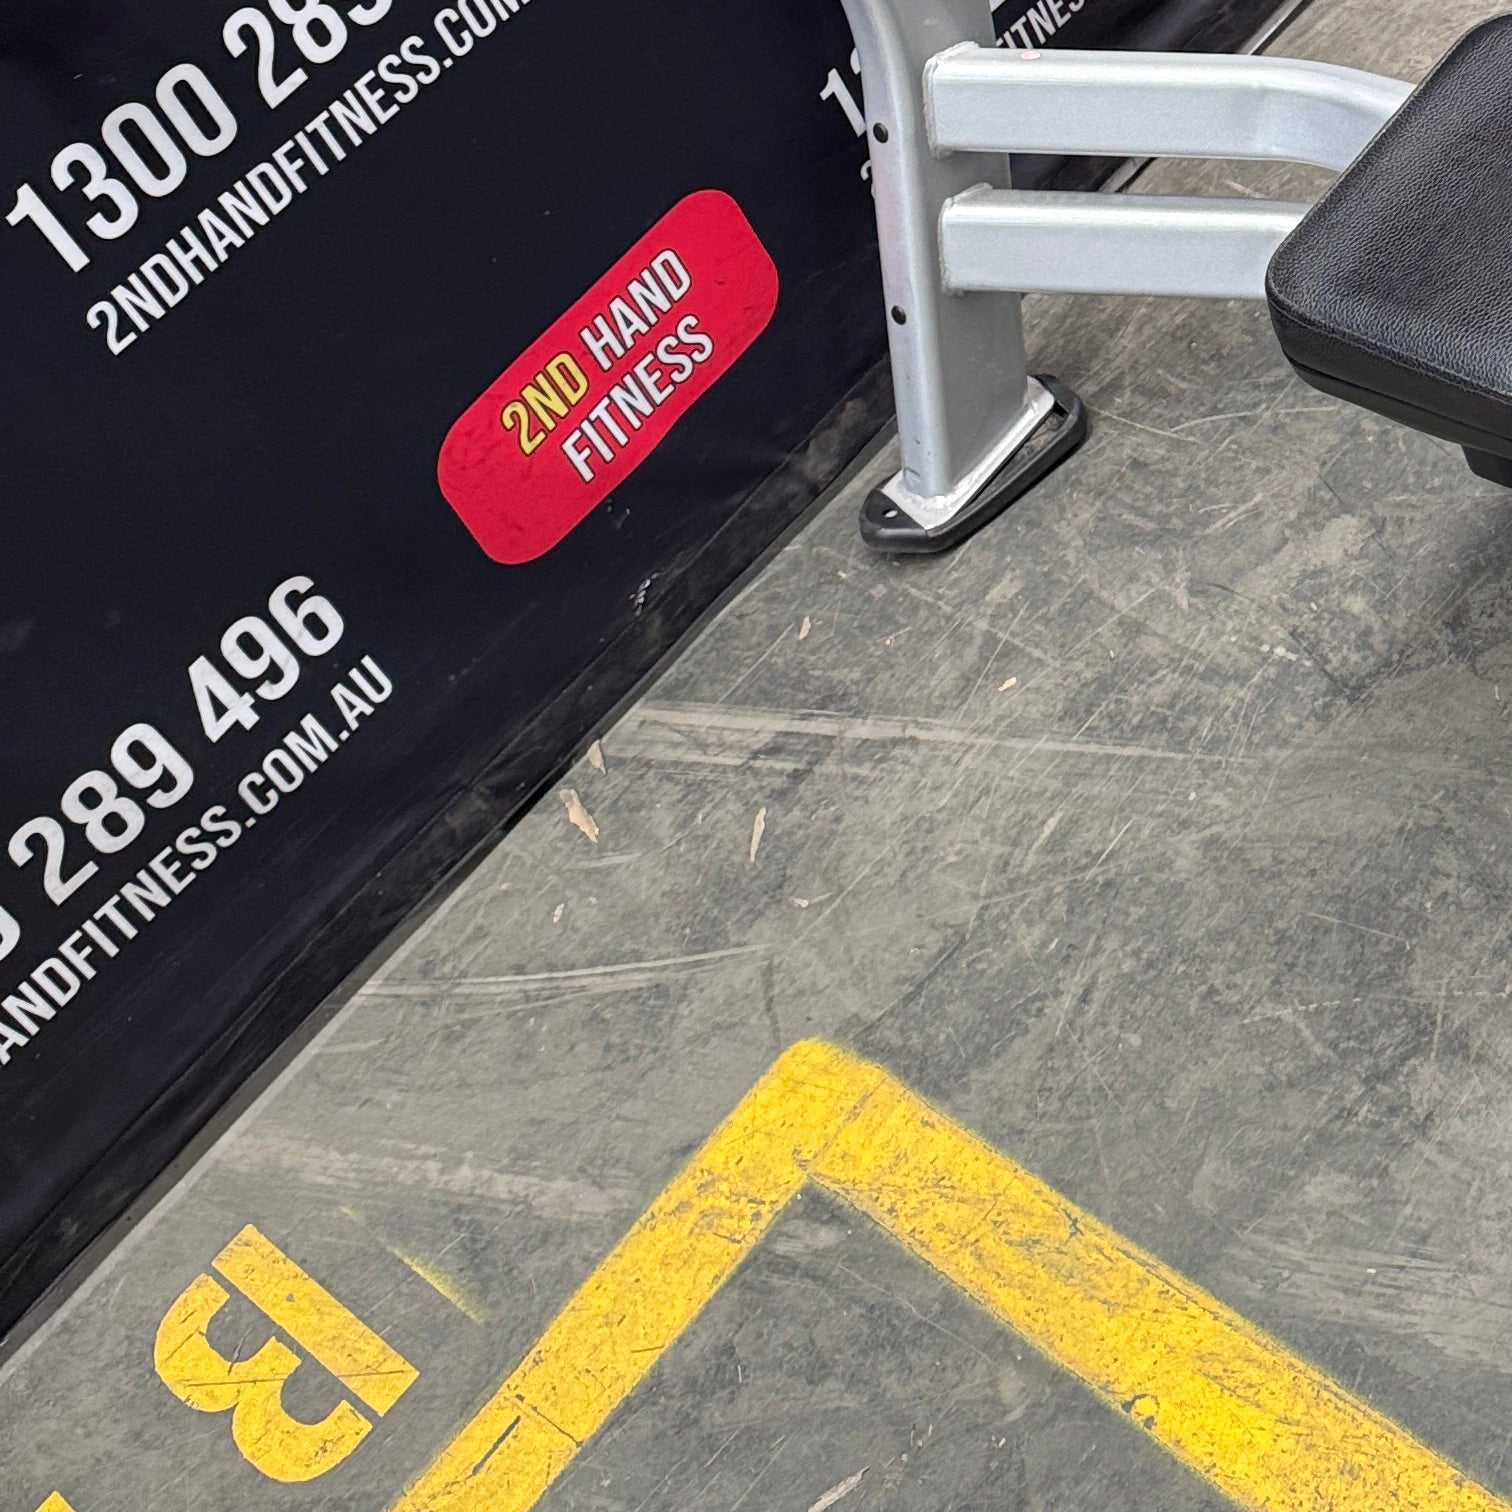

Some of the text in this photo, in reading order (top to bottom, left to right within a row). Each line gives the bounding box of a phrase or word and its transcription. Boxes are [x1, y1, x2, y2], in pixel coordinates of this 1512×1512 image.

[5, 63, 238, 273] 1300
[502, 249, 692, 455] 2ND HAND
[561, 315, 714, 482] FITNESS
[7, 576, 344, 907] 289 496
